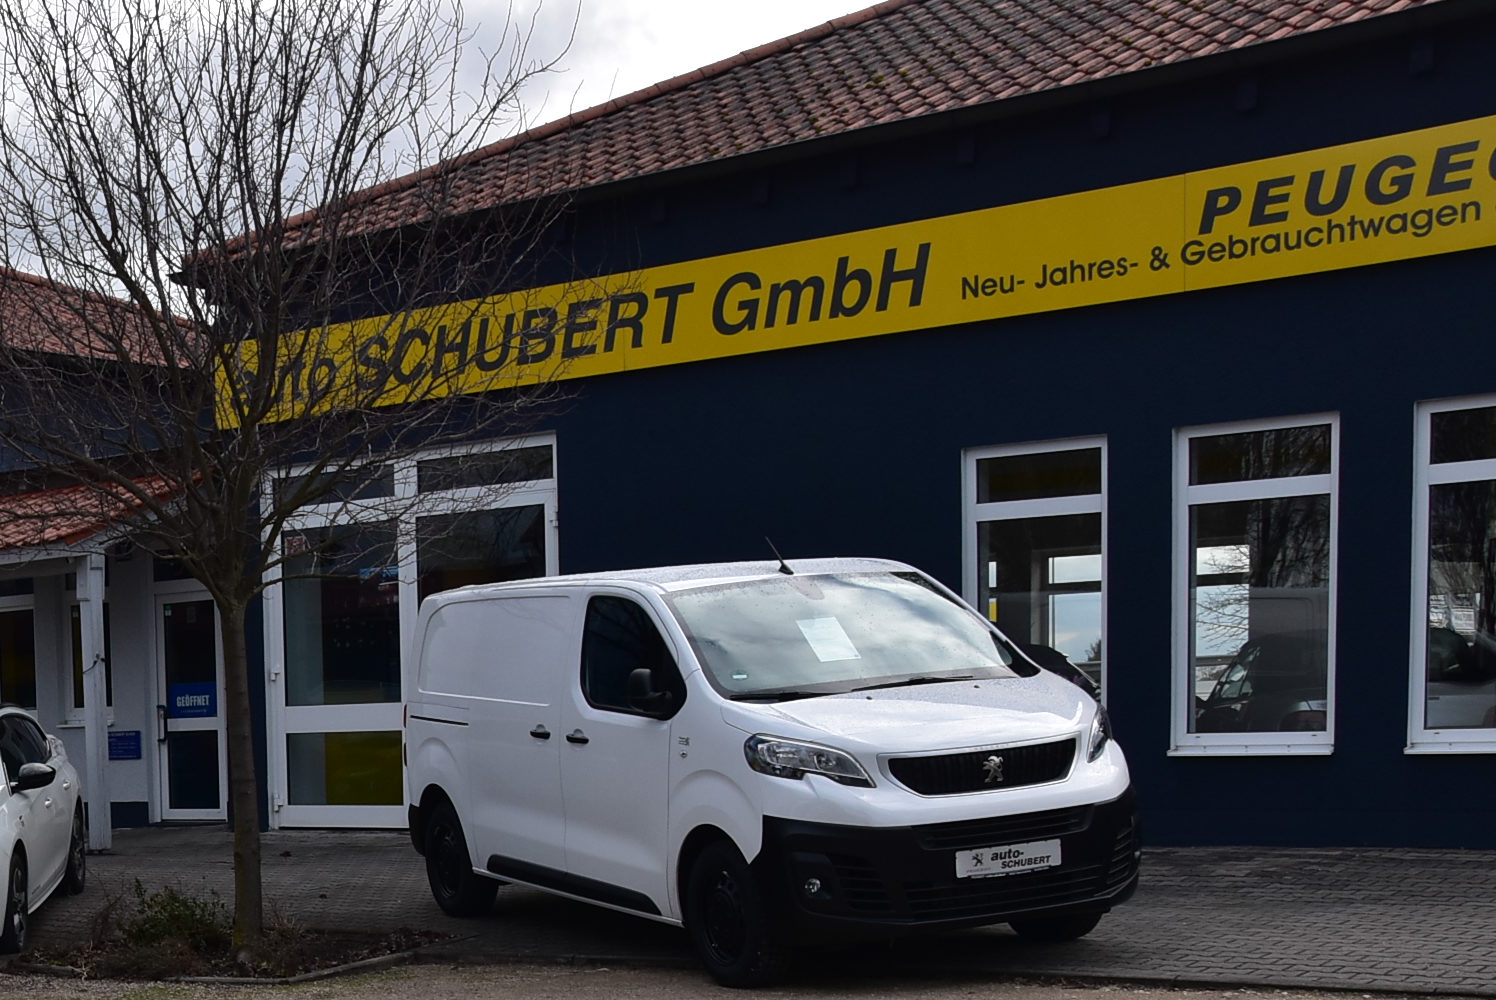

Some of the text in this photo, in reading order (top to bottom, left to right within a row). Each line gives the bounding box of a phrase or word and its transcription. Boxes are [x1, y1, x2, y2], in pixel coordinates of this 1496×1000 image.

[1198, 139, 1496, 236] PEUGE
[961, 200, 1481, 300] Neu- Jahres- & Gebrauchtwagen
[356, 281, 694, 392] SCHUBERT
[711, 242, 932, 336] GmbH
[176, 694, 210, 707] GEÖFFNET
[990, 848, 1024, 861] auto-
[1001, 855, 1051, 869] SCHUBERT
